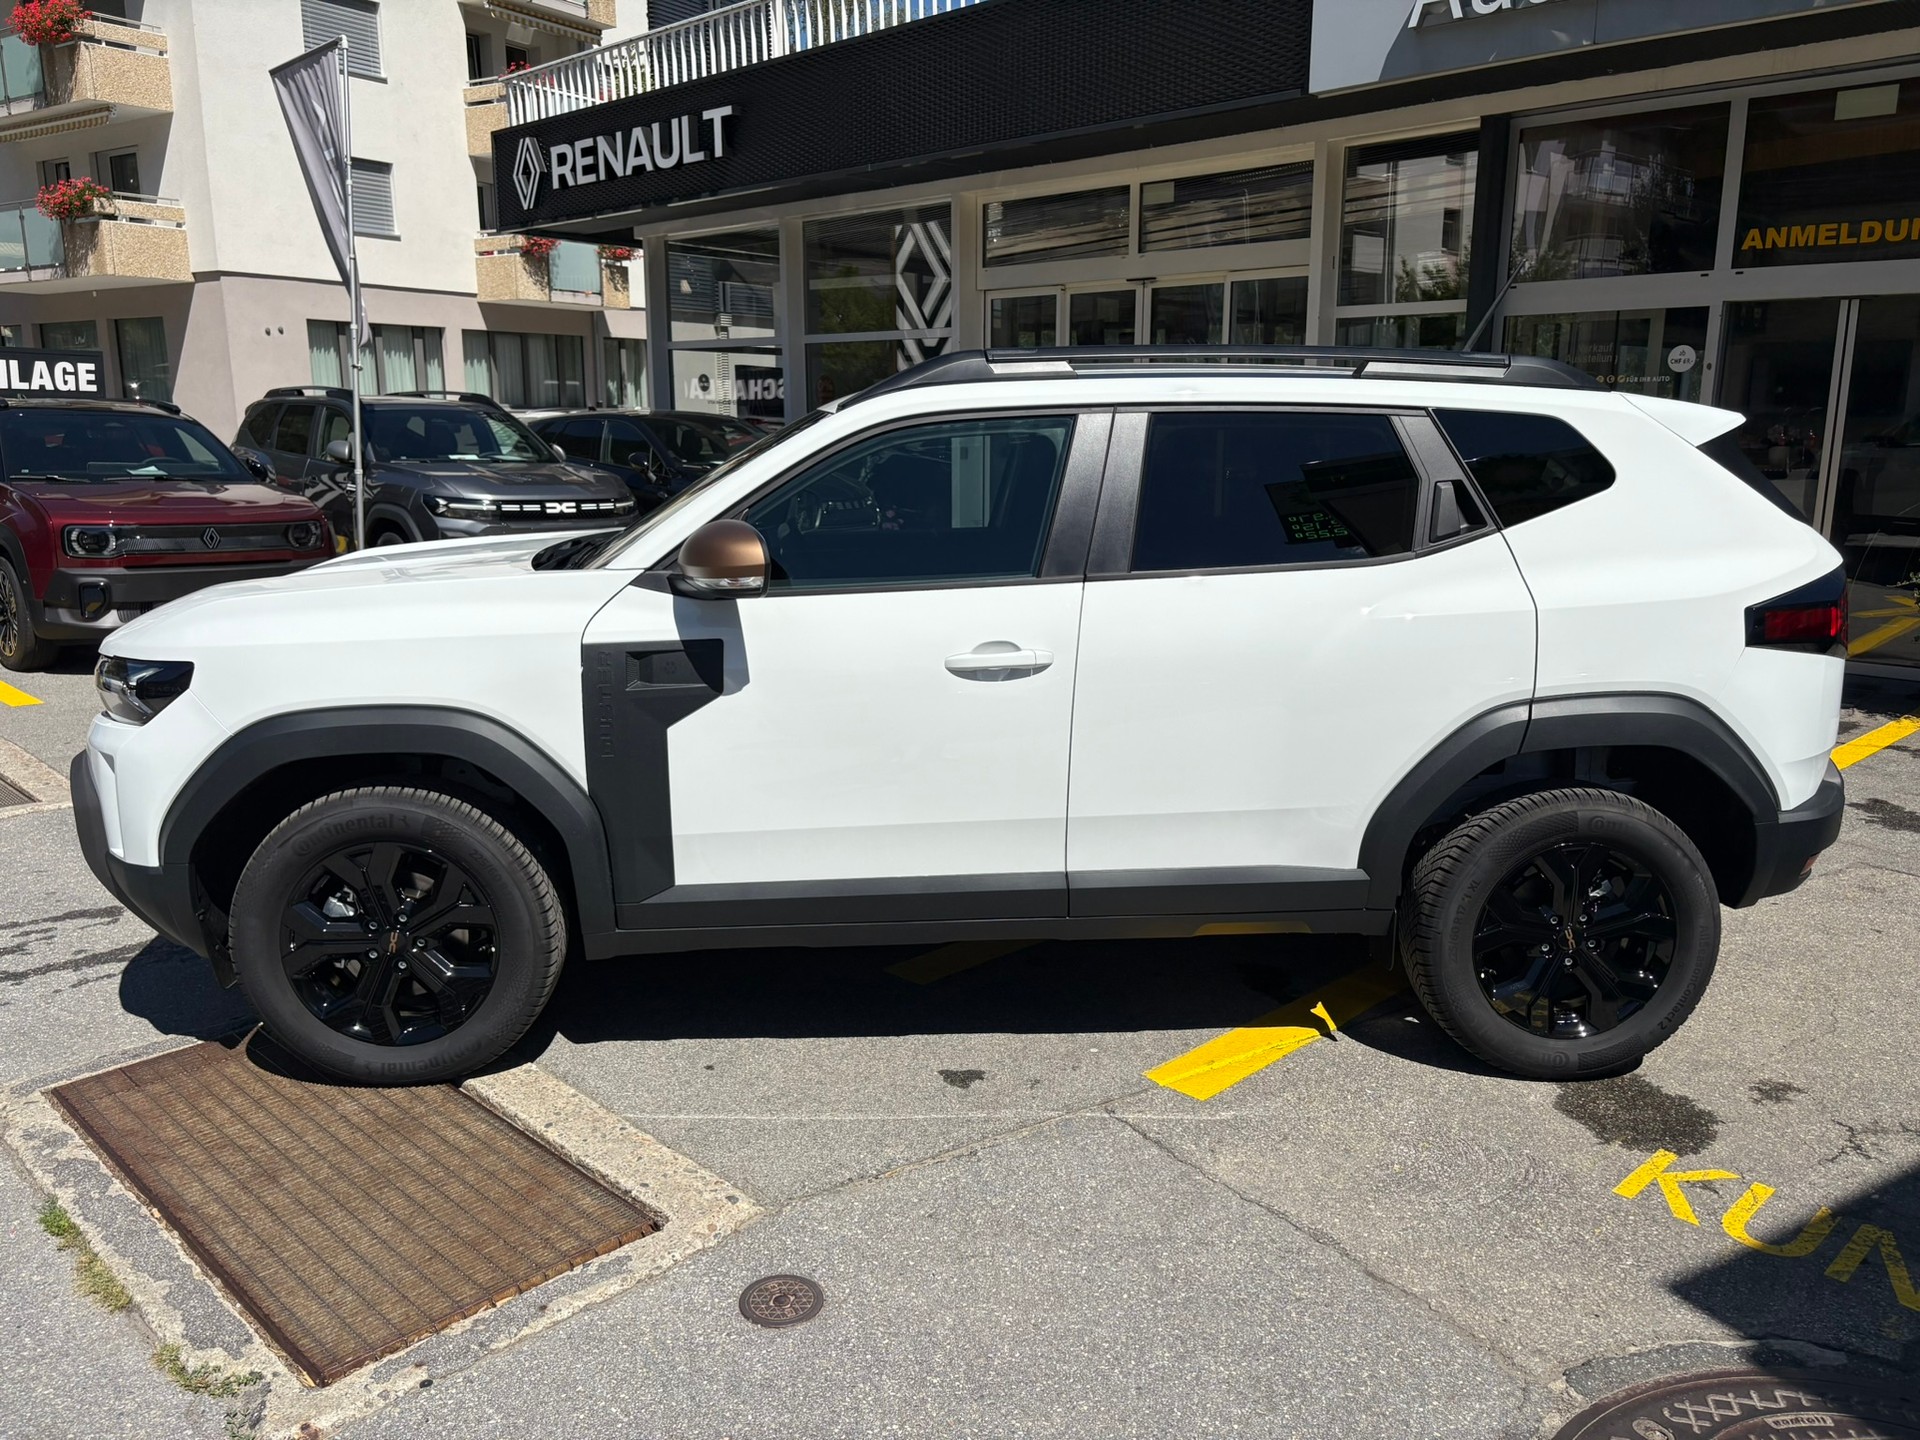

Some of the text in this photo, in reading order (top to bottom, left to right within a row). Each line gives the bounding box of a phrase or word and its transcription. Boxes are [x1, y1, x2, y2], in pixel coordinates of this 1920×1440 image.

[550, 105, 734, 190] RENAULT
[1652, 375, 1671, 383] AUTO
[291, 813, 395, 857] Continental
